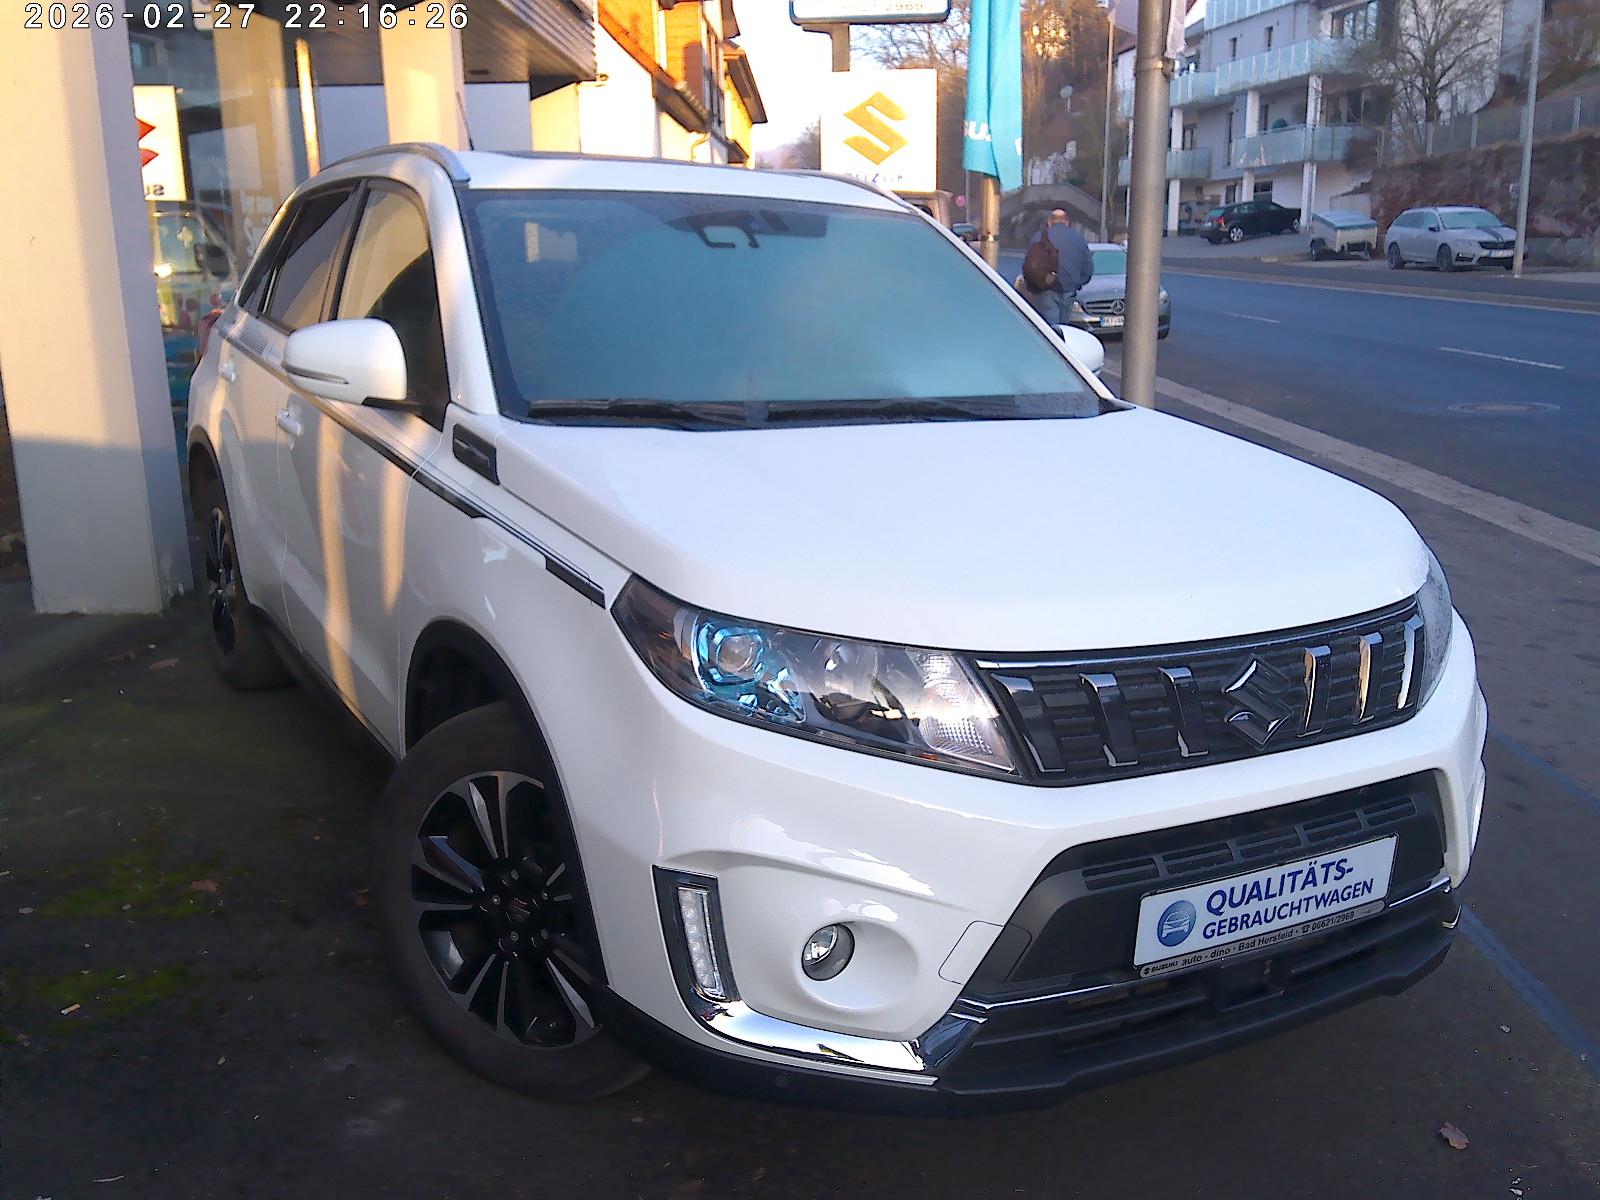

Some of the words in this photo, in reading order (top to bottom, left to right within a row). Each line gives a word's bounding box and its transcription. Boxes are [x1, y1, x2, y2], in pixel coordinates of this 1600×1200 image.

[1202, 878, 1374, 940] GEBRAUCHTWAGEN
[1206, 858, 1354, 916] QUALITÄTS-
[1150, 961, 1179, 973] SUZUKI
[1180, 955, 1202, 966] auto
[1210, 947, 1231, 959] dino
[1238, 938, 1256, 952] Bad
[1258, 929, 1293, 946] Hersfeld
